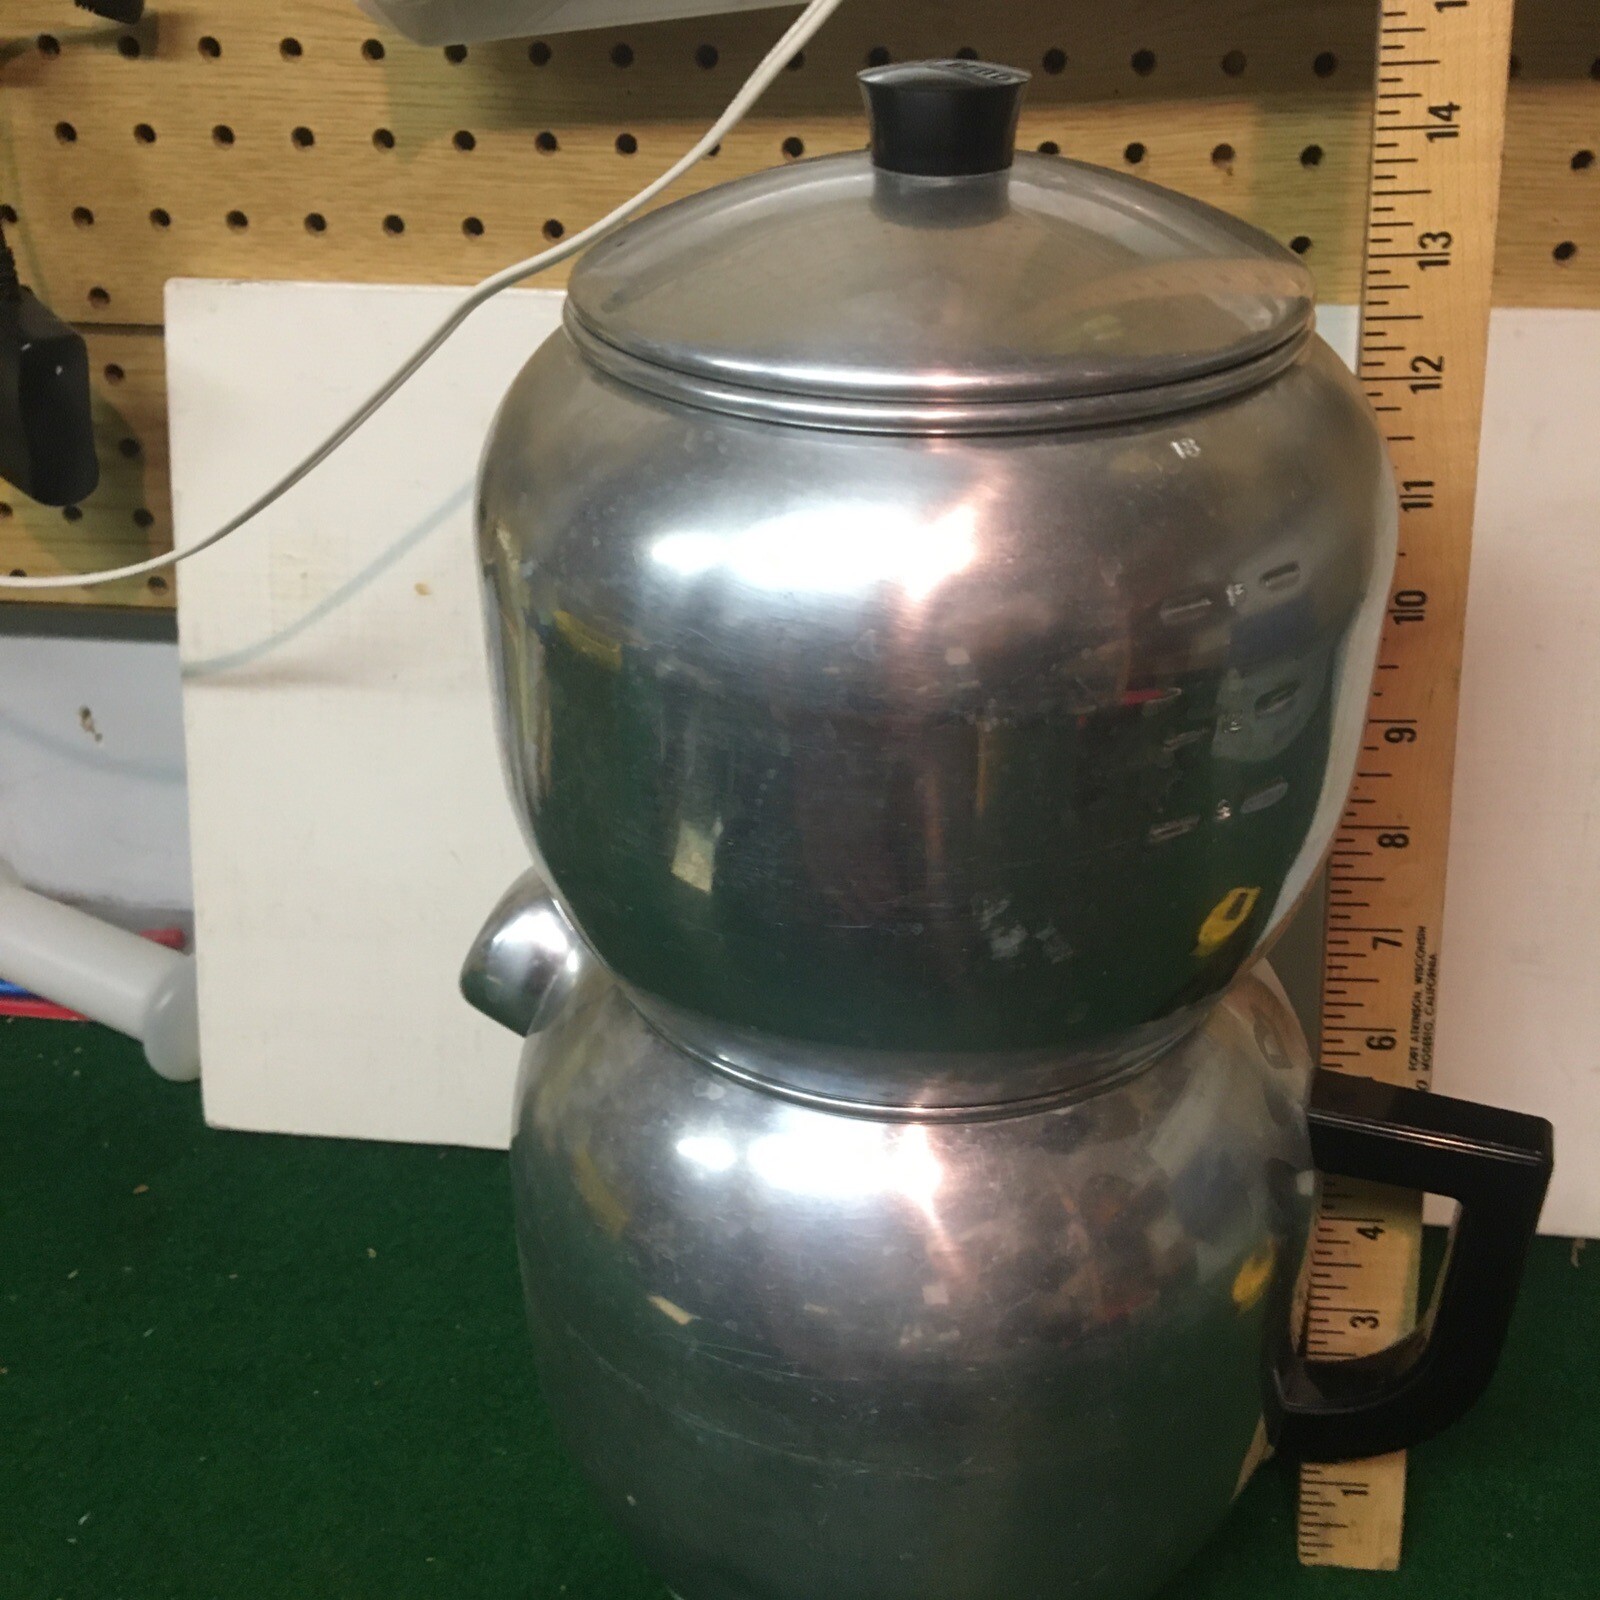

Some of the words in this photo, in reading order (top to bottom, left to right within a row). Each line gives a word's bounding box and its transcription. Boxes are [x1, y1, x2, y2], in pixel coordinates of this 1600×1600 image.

[1425, 102, 1461, 143] 14
[1416, 231, 1453, 271] 13
[1409, 355, 1444, 394] 12
[1401, 480, 1435, 512] 11
[1393, 589, 1427, 625] 10
[1384, 726, 1417, 744] 9
[1376, 832, 1410, 849] 8
[1371, 935, 1403, 951] 7
[1366, 1034, 1397, 1051] 6
[1356, 1225, 1386, 1241] 4
[1350, 1314, 1380, 1330] 3
